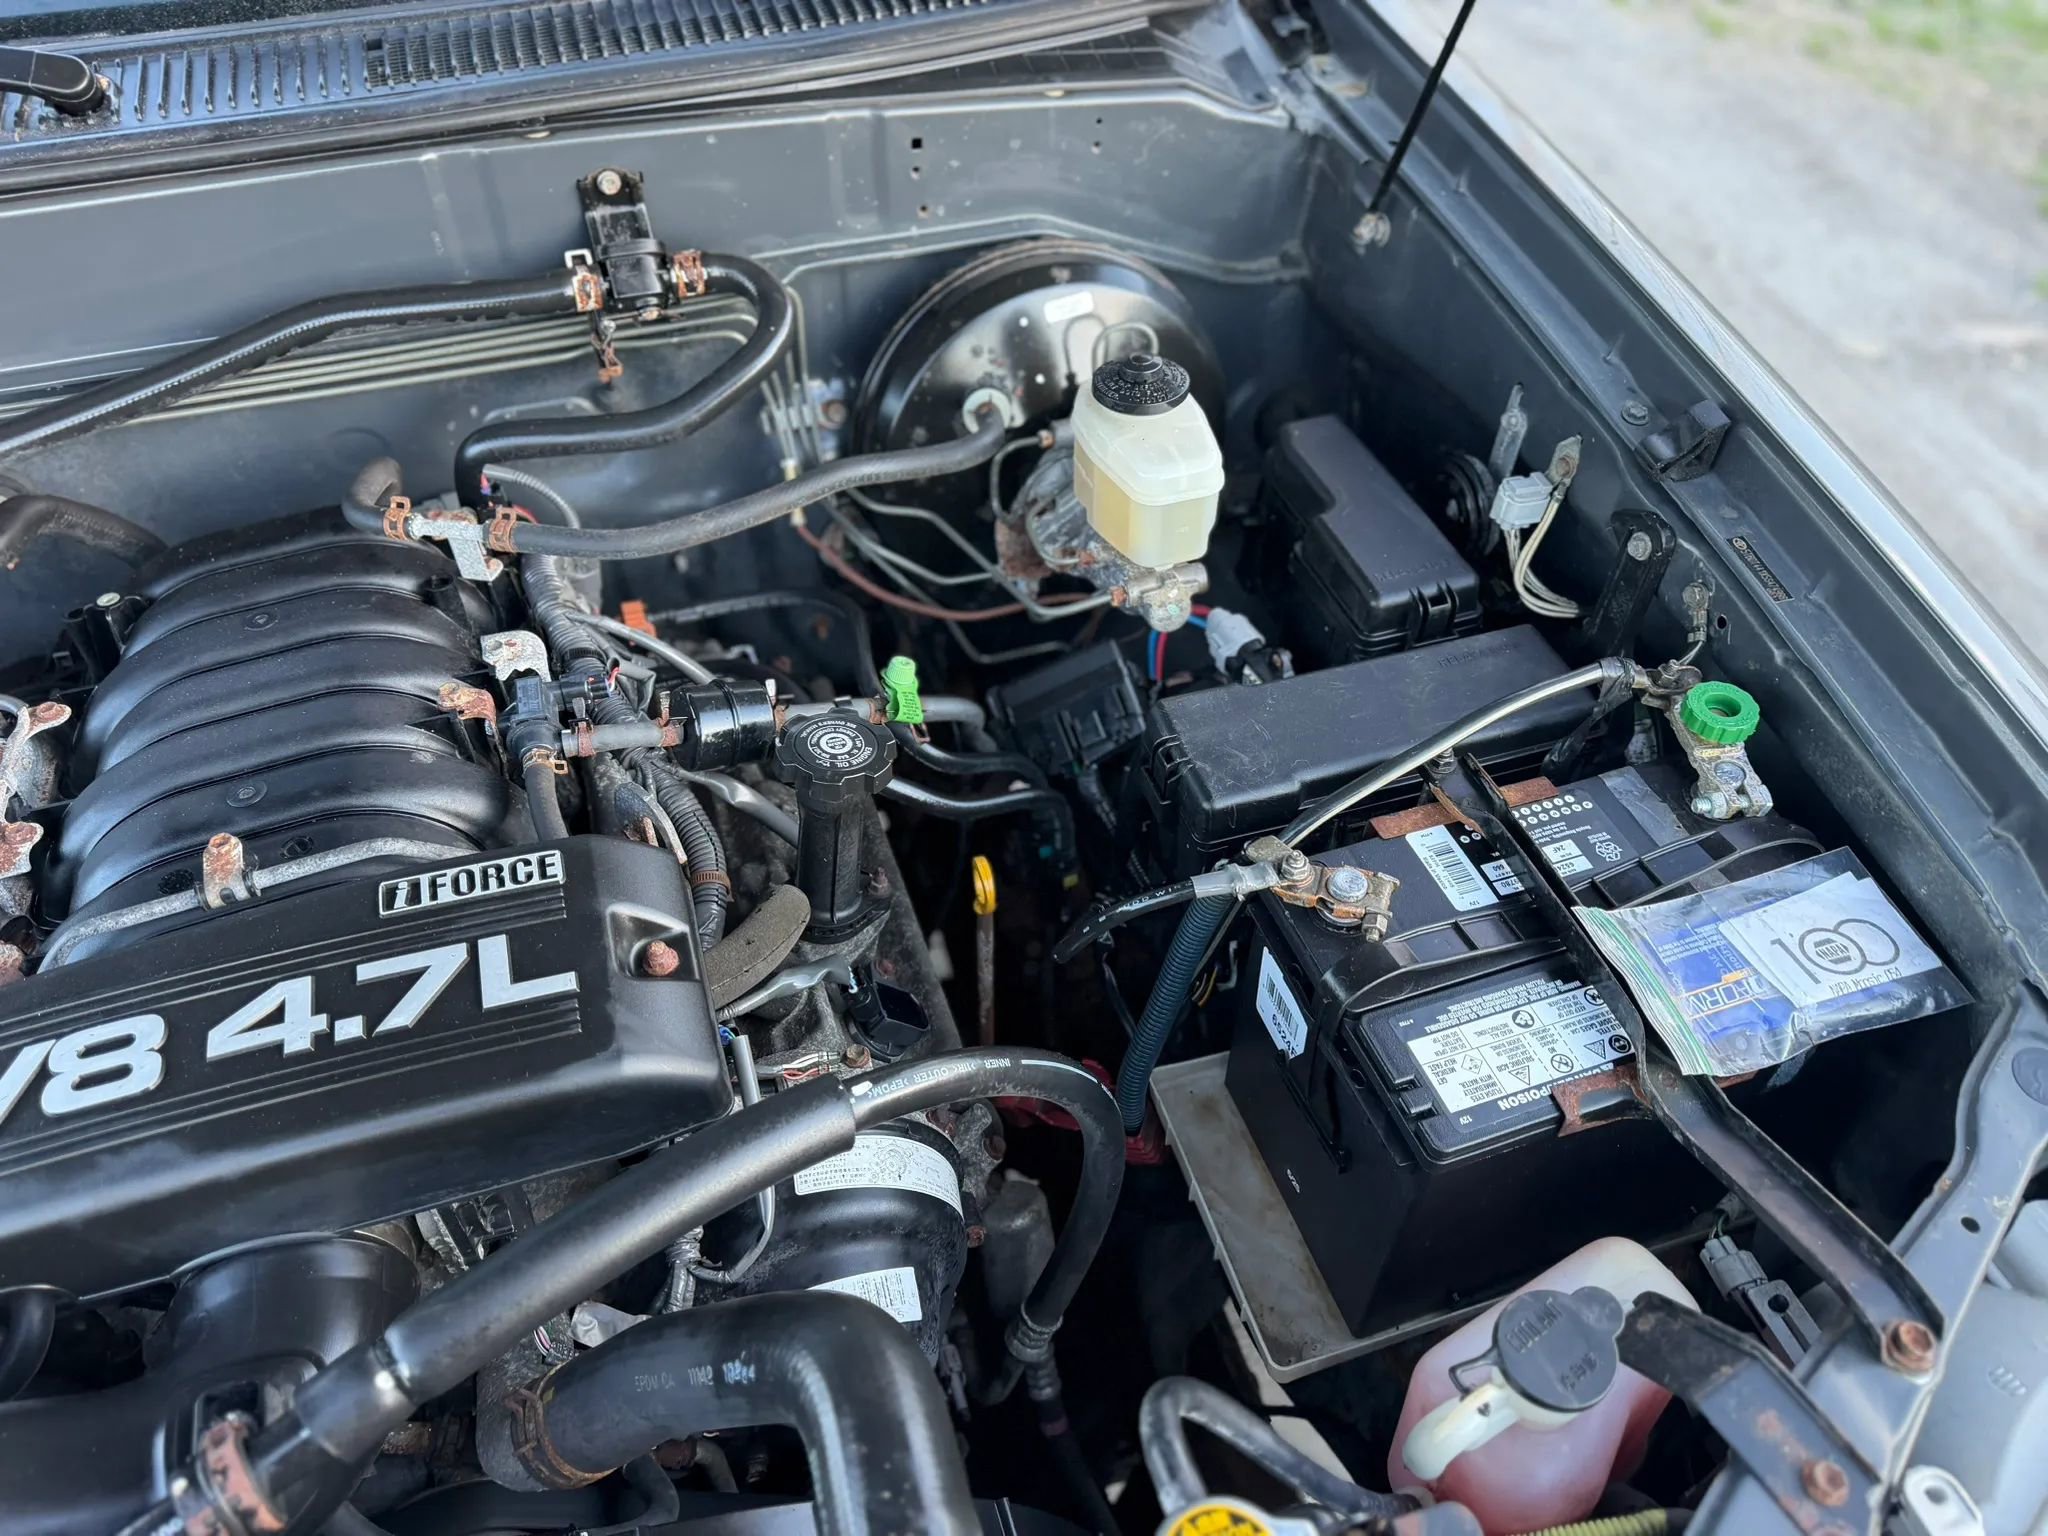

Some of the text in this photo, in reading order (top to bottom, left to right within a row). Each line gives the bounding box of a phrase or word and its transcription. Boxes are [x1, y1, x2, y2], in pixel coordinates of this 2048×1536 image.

[850, 747, 873, 766] ENGINE
[1551, 845, 1567, 854] 24F
[1555, 862, 1576, 872] 6524
[1820, 942, 1848, 962] NAPA
[207, 934, 580, 1062] 4.7L
[984, 1057, 1011, 1069] INNER
[1442, 1058, 1458, 1067] HELP
[1496, 1055, 1536, 1073] SULFURIC ACID
[913, 1067, 948, 1082] OUTER
[1432, 1067, 1457, 1079] MEDICAL
[1479, 1074, 1495, 1084] WITH
[1437, 1077, 1449, 1086] GET
[1462, 1081, 1499, 1097] IMMEDIATELY
[1470, 1088, 1503, 1103] FLUSH EYES
[1458, 1115, 1474, 1126] 12V
